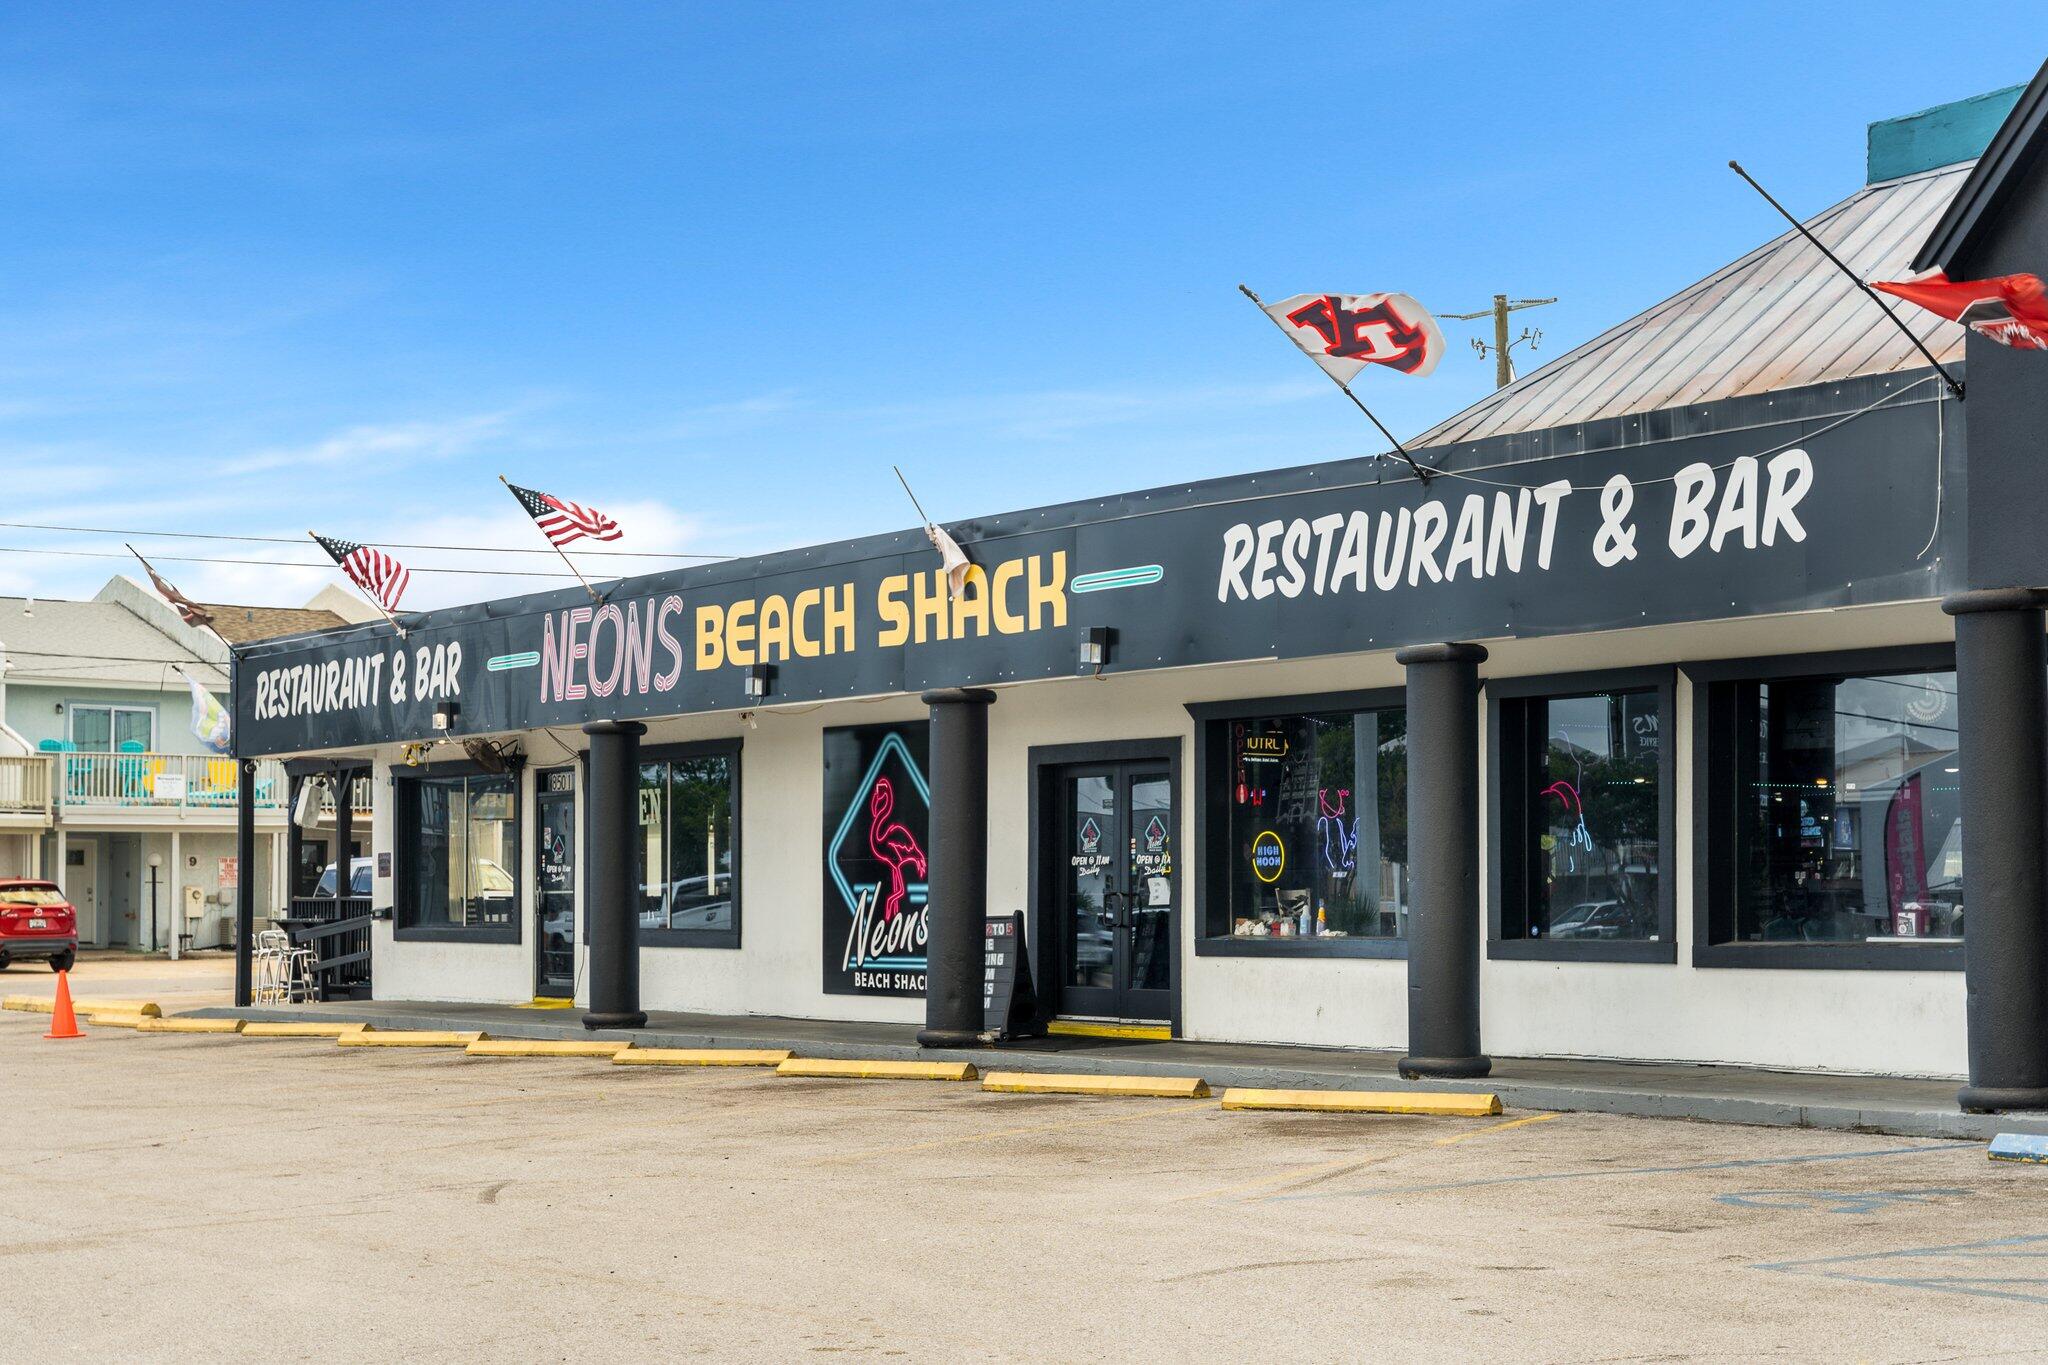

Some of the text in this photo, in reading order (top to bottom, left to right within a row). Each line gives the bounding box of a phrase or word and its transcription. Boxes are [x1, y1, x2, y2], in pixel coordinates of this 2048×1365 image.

[1217, 449, 1813, 603] RESTAURANT & BAR
[541, 550, 1067, 704] NEONS BEACH SHACK
[255, 641, 462, 721] RESTAURANT & BAR
[551, 773, 573, 791] 8501
[639, 788, 661, 825] EN
[1257, 845, 1279, 856] HIGH
[189, 856, 197, 866] 9
[1071, 856, 1089, 866] OPEN
[1136, 855, 1153, 865] OPEN
[1256, 856, 1281, 867] NOON
[1079, 864, 1100, 876] Daily
[843, 881, 929, 972] Neons
[985, 953, 1004, 966] ING
[855, 972, 928, 991] BEACH SHAC
